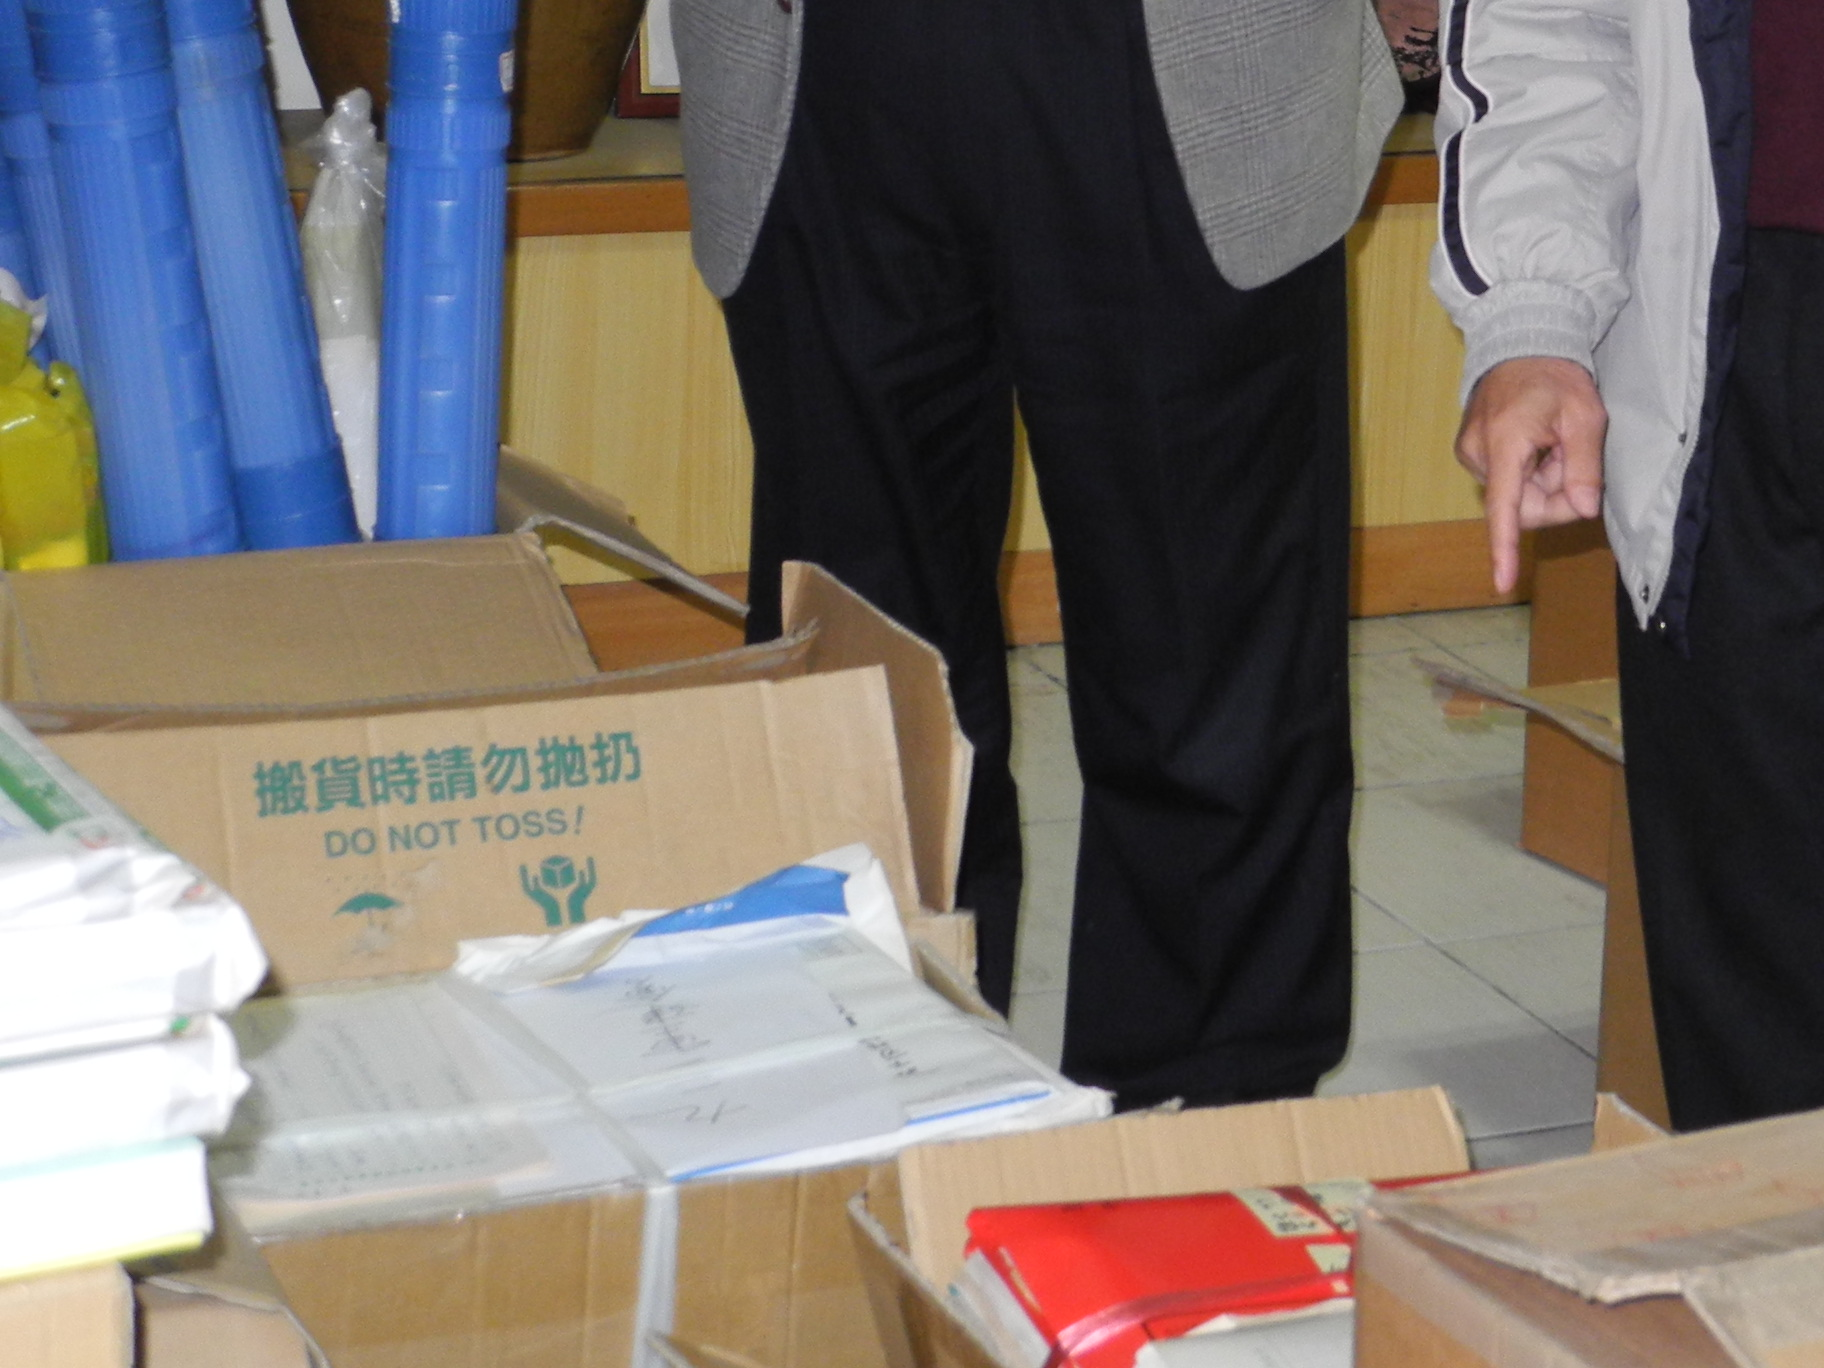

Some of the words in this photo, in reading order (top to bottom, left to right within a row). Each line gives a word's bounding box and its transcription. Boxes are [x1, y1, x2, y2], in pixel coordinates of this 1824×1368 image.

[324, 827, 378, 858] DO
[387, 819, 461, 852] NOT
[472, 805, 585, 843] TOSS!
